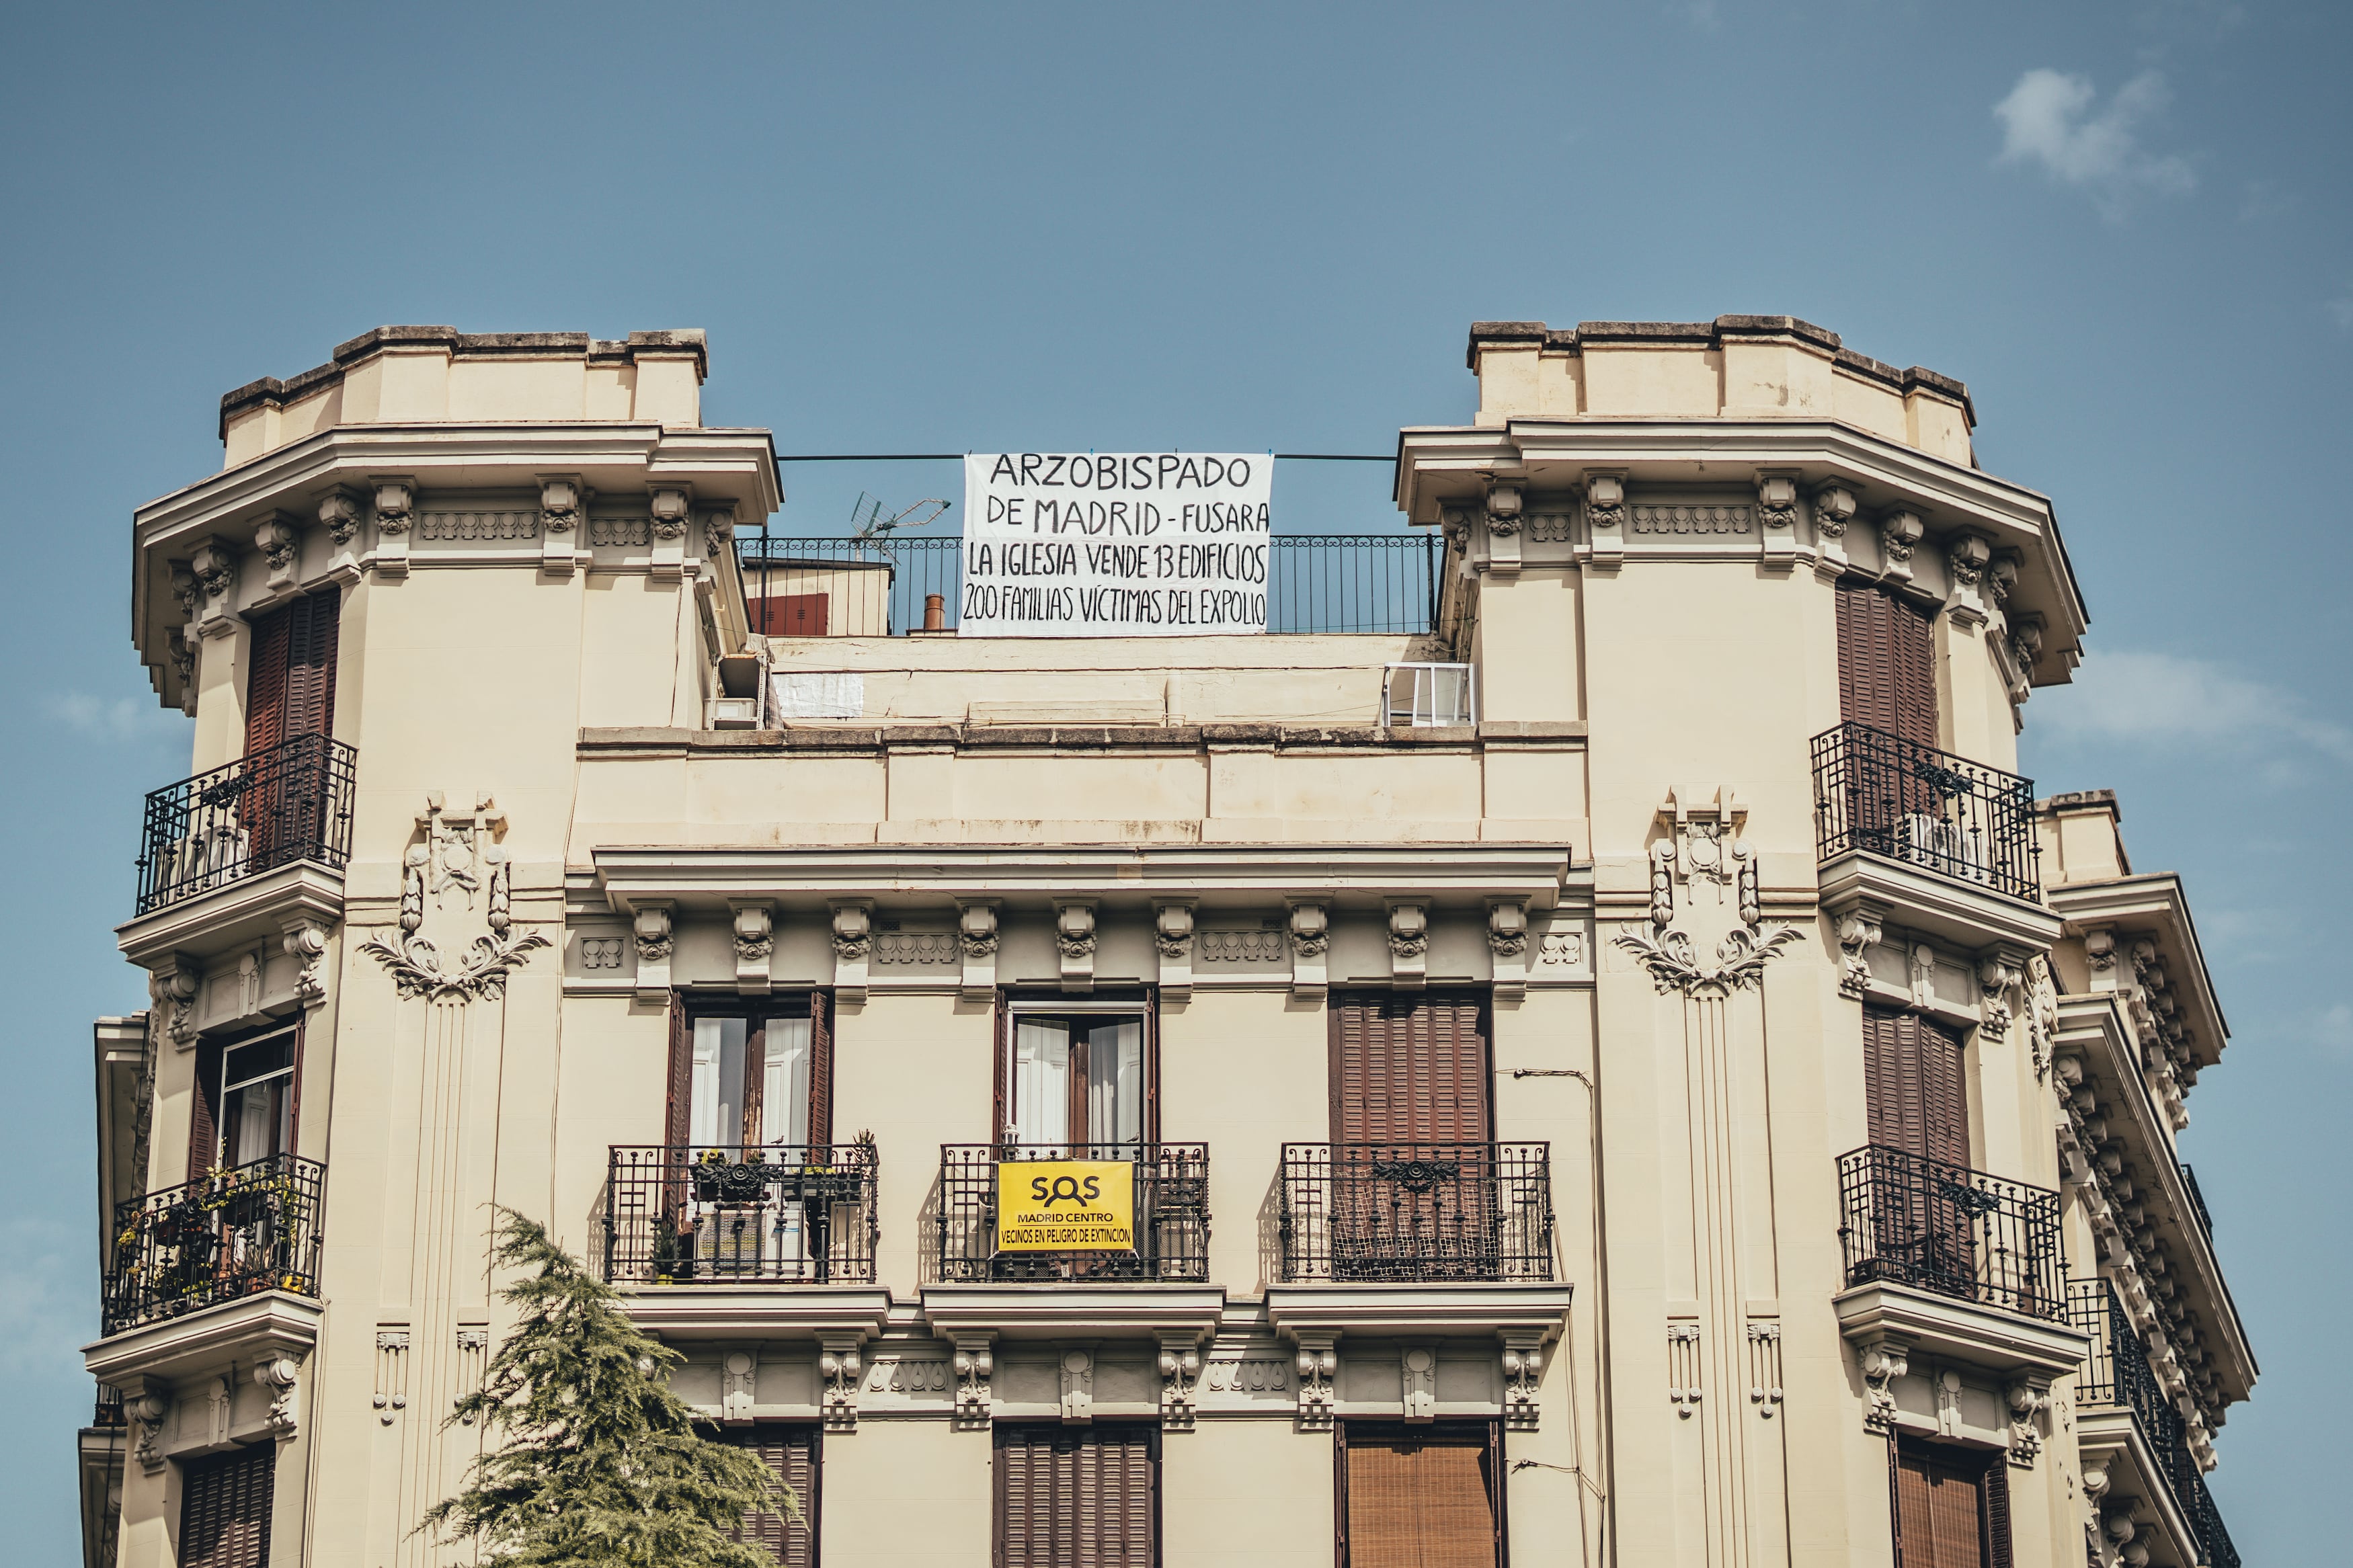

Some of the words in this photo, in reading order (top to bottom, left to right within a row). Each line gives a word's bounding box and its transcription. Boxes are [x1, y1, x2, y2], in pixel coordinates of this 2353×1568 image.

[990, 454, 1250, 491] ARZOBISPADO
[988, 495, 1025, 525] DE
[1034, 499, 1160, 536] MADRID
[1183, 502, 1269, 533] FUSARA
[969, 542, 993, 576] LA
[1002, 543, 1077, 576] IGLESIA
[1085, 543, 1149, 579] VENDE
[1153, 544, 1174, 579] 13
[1178, 542, 1267, 584] EDIFICIOS
[963, 583, 998, 620] 200
[1002, 585, 1074, 620] FAMILIAS
[1080, 585, 1162, 624] VÍCTIMAS
[1168, 589, 1195, 624] DEL
[1200, 589, 1266, 626] EXPOLIO
[1031, 1175, 1100, 1207] SOS
[1001, 1229, 1033, 1243] VECINOS
[1035, 1229, 1045, 1243] EN
[1047, 1228, 1078, 1243] PELIGRO
[1079, 1228, 1089, 1243] DE
[1090, 1227, 1130, 1243] EXTINCION
[1018, 1212, 1064, 1223] MADRID
[1066, 1212, 1113, 1223] CENTRO
